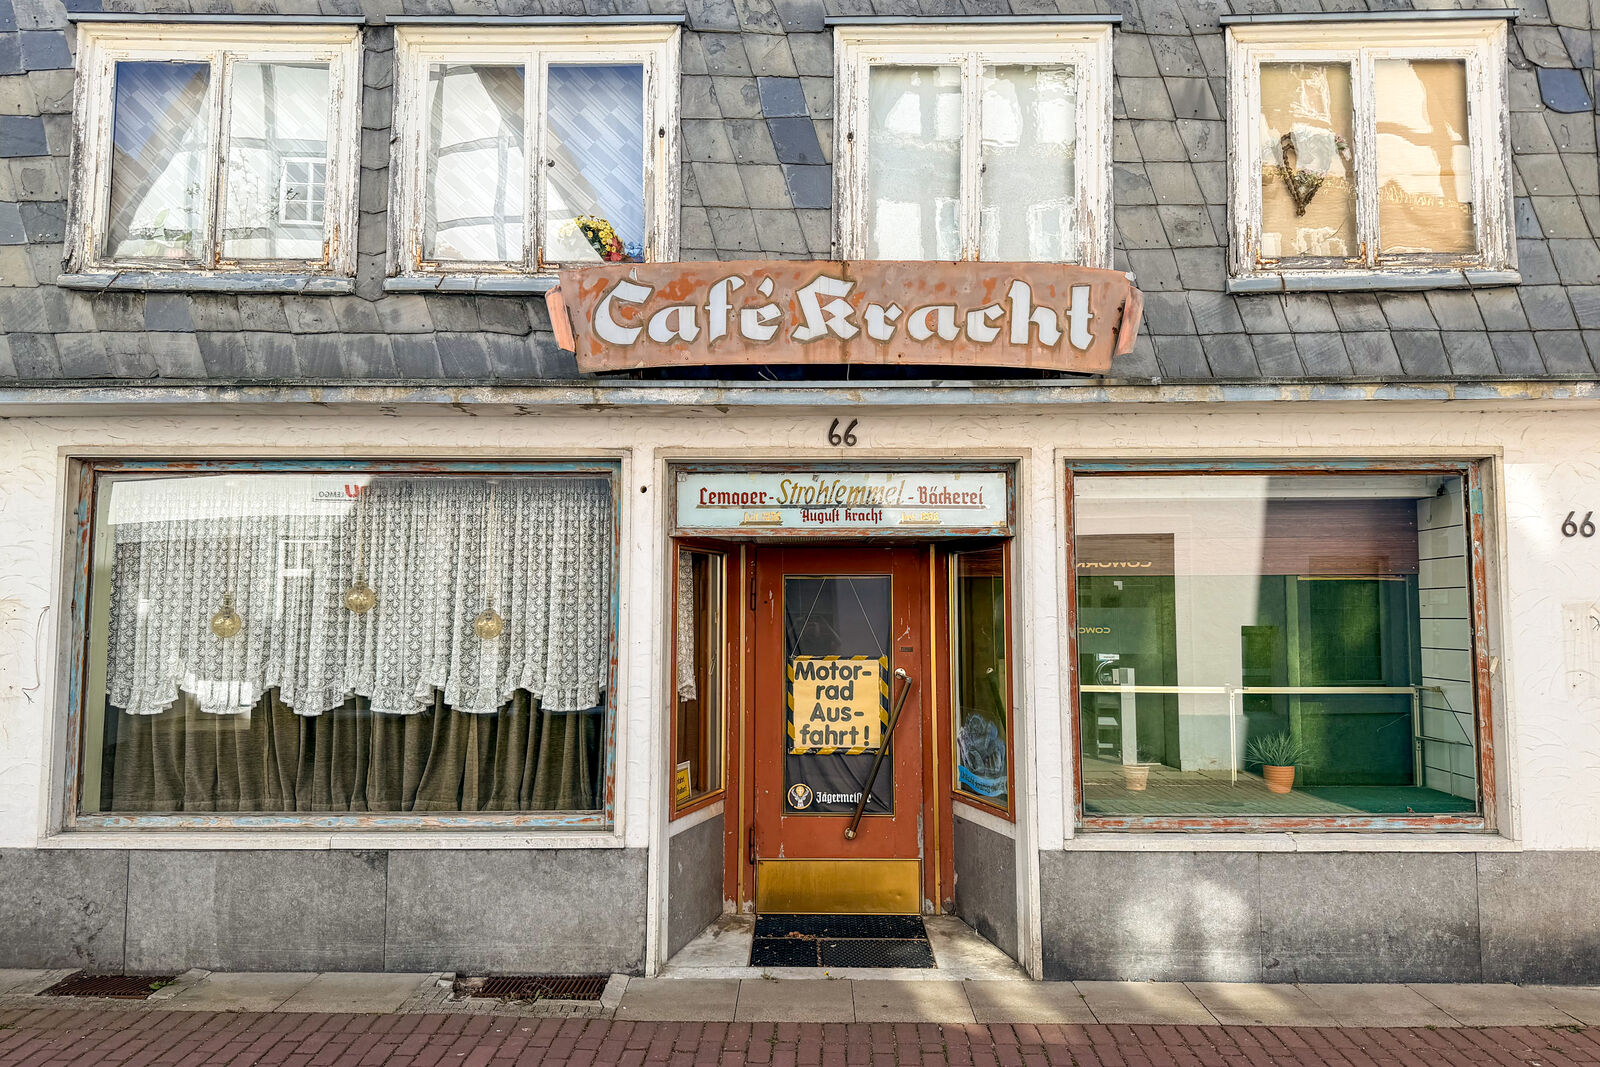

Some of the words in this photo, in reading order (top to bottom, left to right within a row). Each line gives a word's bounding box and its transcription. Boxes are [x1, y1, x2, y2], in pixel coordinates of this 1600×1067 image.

[594, 273, 781, 346] Café
[790, 274, 1095, 351] Kracht
[828, 418, 858, 447] 66
[1561, 510, 1596, 538] 66
[794, 661, 872, 681] Motor-
[815, 680, 854, 701] rad
[810, 702, 865, 723] Aus-
